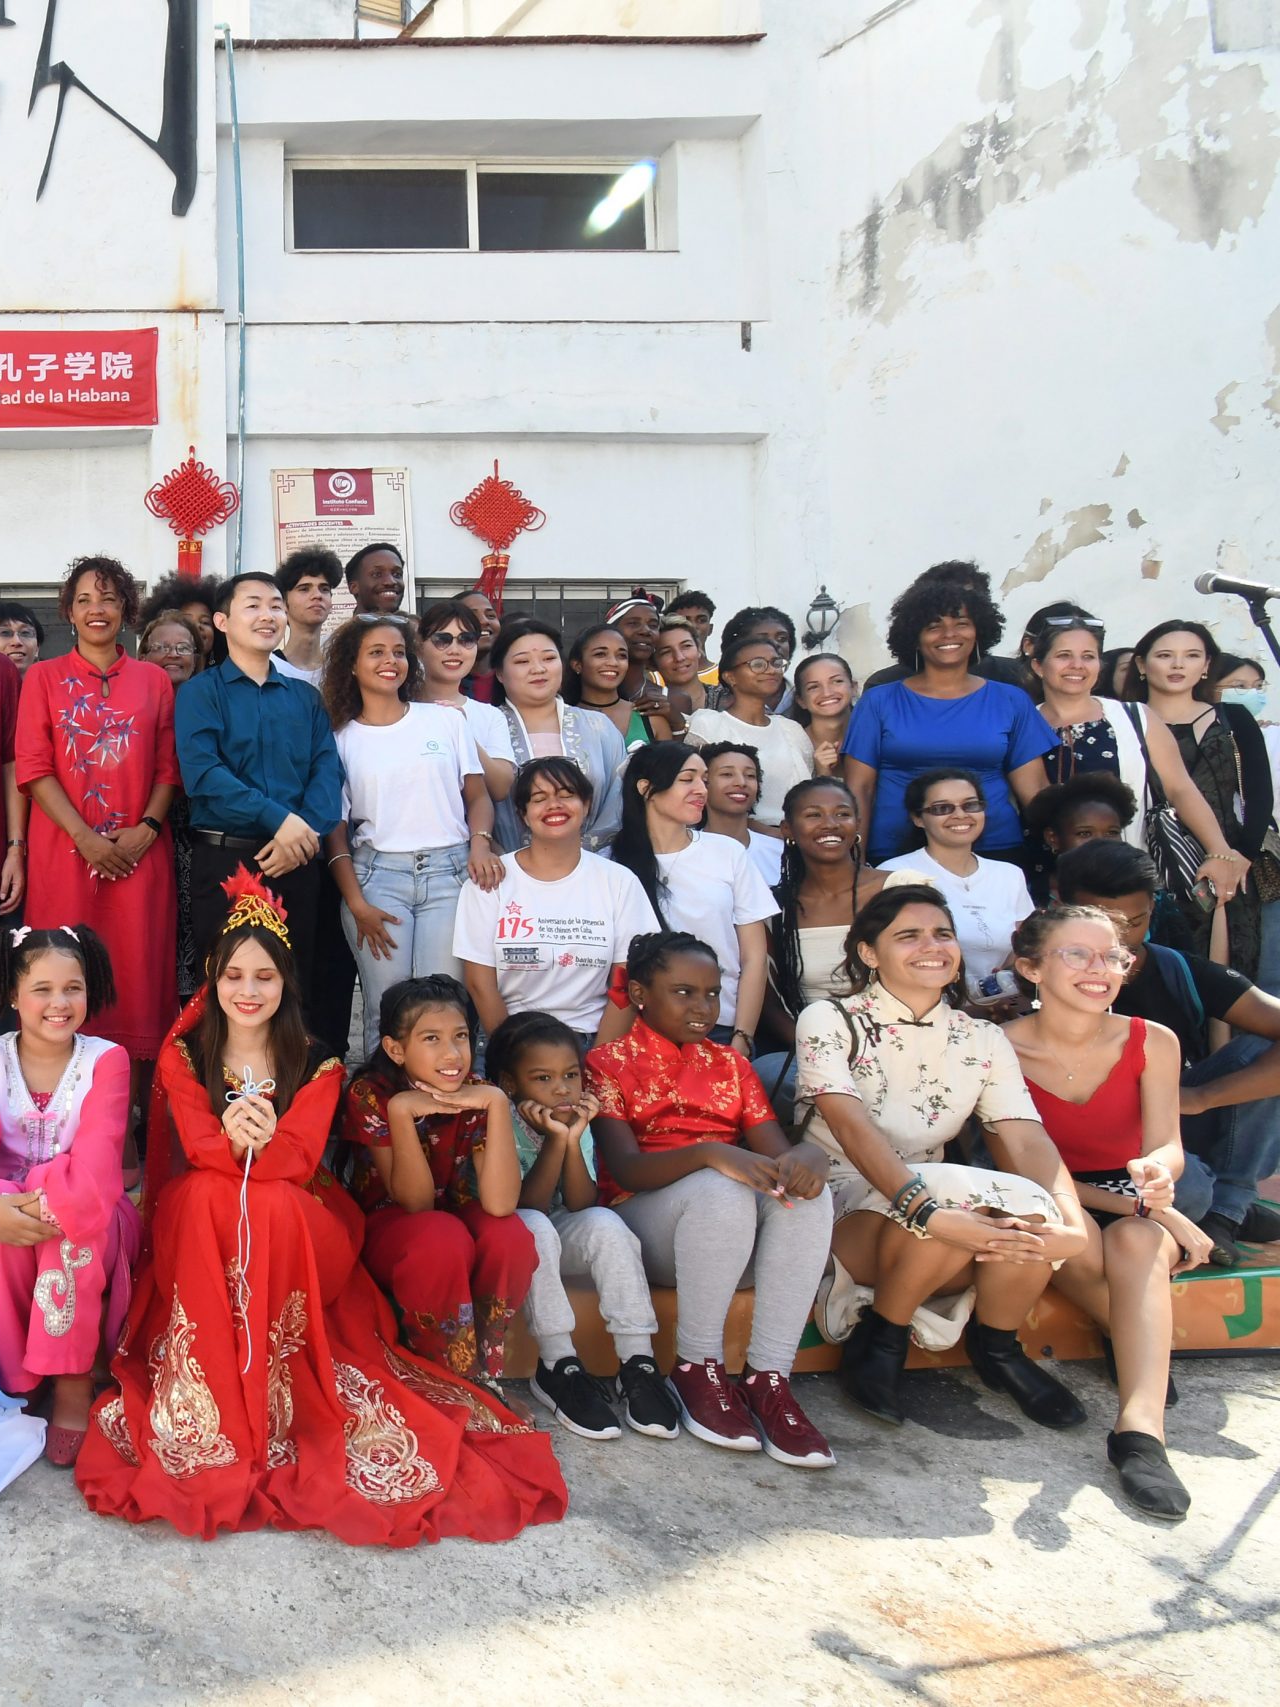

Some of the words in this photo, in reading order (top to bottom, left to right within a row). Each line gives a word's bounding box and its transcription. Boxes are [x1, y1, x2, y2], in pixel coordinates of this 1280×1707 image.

[24, 389, 45, 404] de
[49, 388, 64, 403] la
[68, 388, 130, 402] Habana
[538, 917, 567, 925] Aniversario
[582, 918, 605, 926] presencia
[497, 917, 535, 940] 175
[580, 926, 592, 934] Cuba
